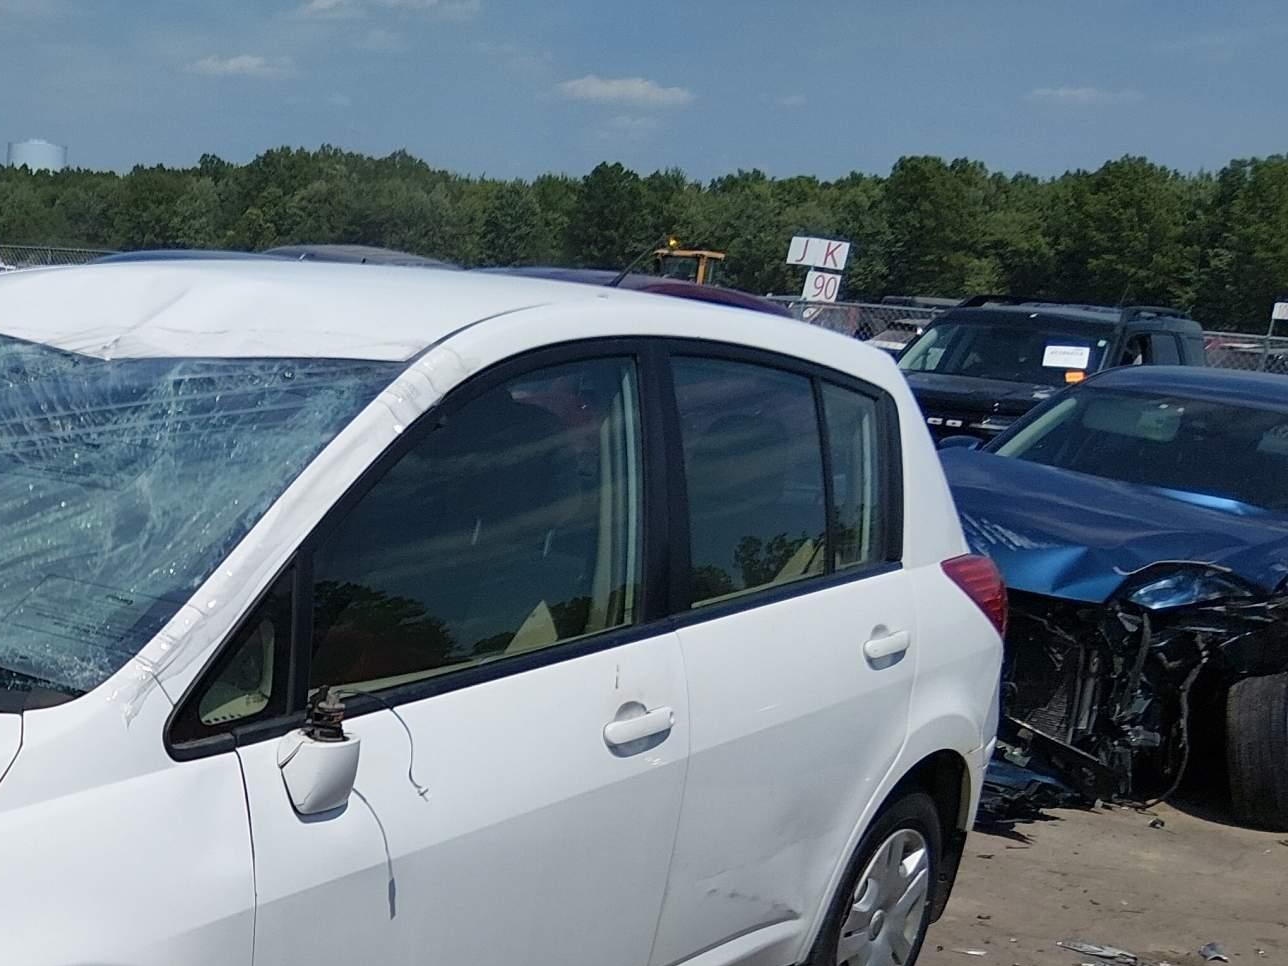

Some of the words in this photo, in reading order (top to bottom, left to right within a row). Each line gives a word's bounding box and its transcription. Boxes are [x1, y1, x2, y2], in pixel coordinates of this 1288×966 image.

[795, 239, 809, 262] J
[823, 242, 843, 267] K
[812, 274, 838, 300] 90
